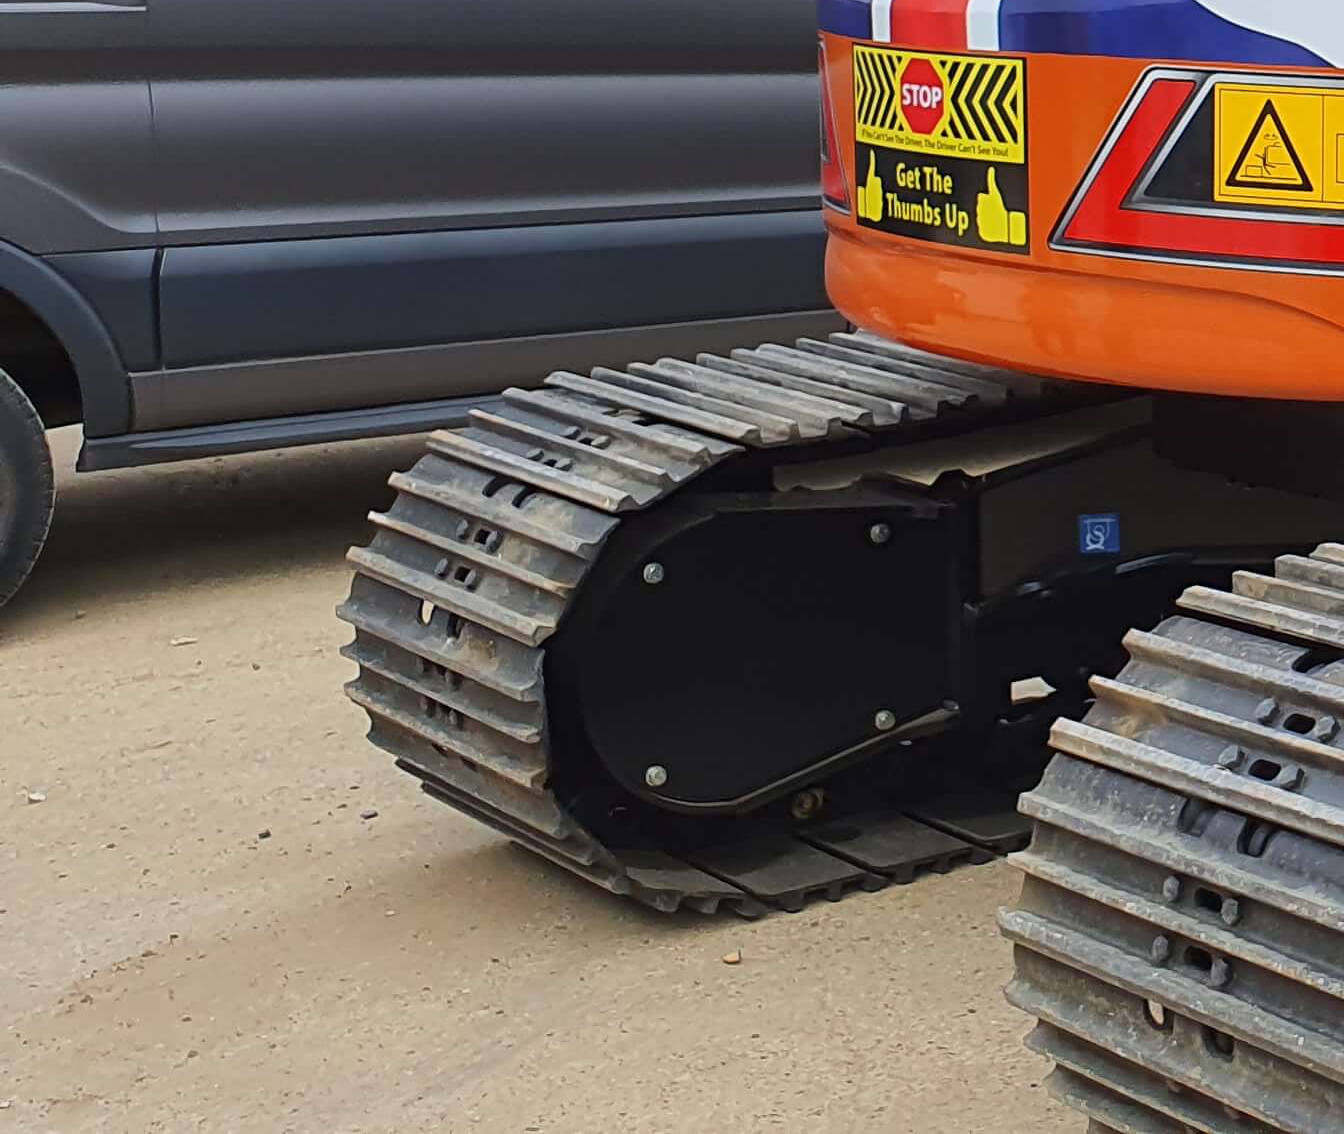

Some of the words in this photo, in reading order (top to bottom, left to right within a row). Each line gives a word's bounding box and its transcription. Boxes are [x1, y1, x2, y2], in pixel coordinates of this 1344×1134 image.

[902, 83, 942, 110] STOP
[896, 162, 921, 190] Get
[923, 166, 953, 194] The
[886, 192, 941, 227] Thumbs
[945, 203, 969, 236] Up
